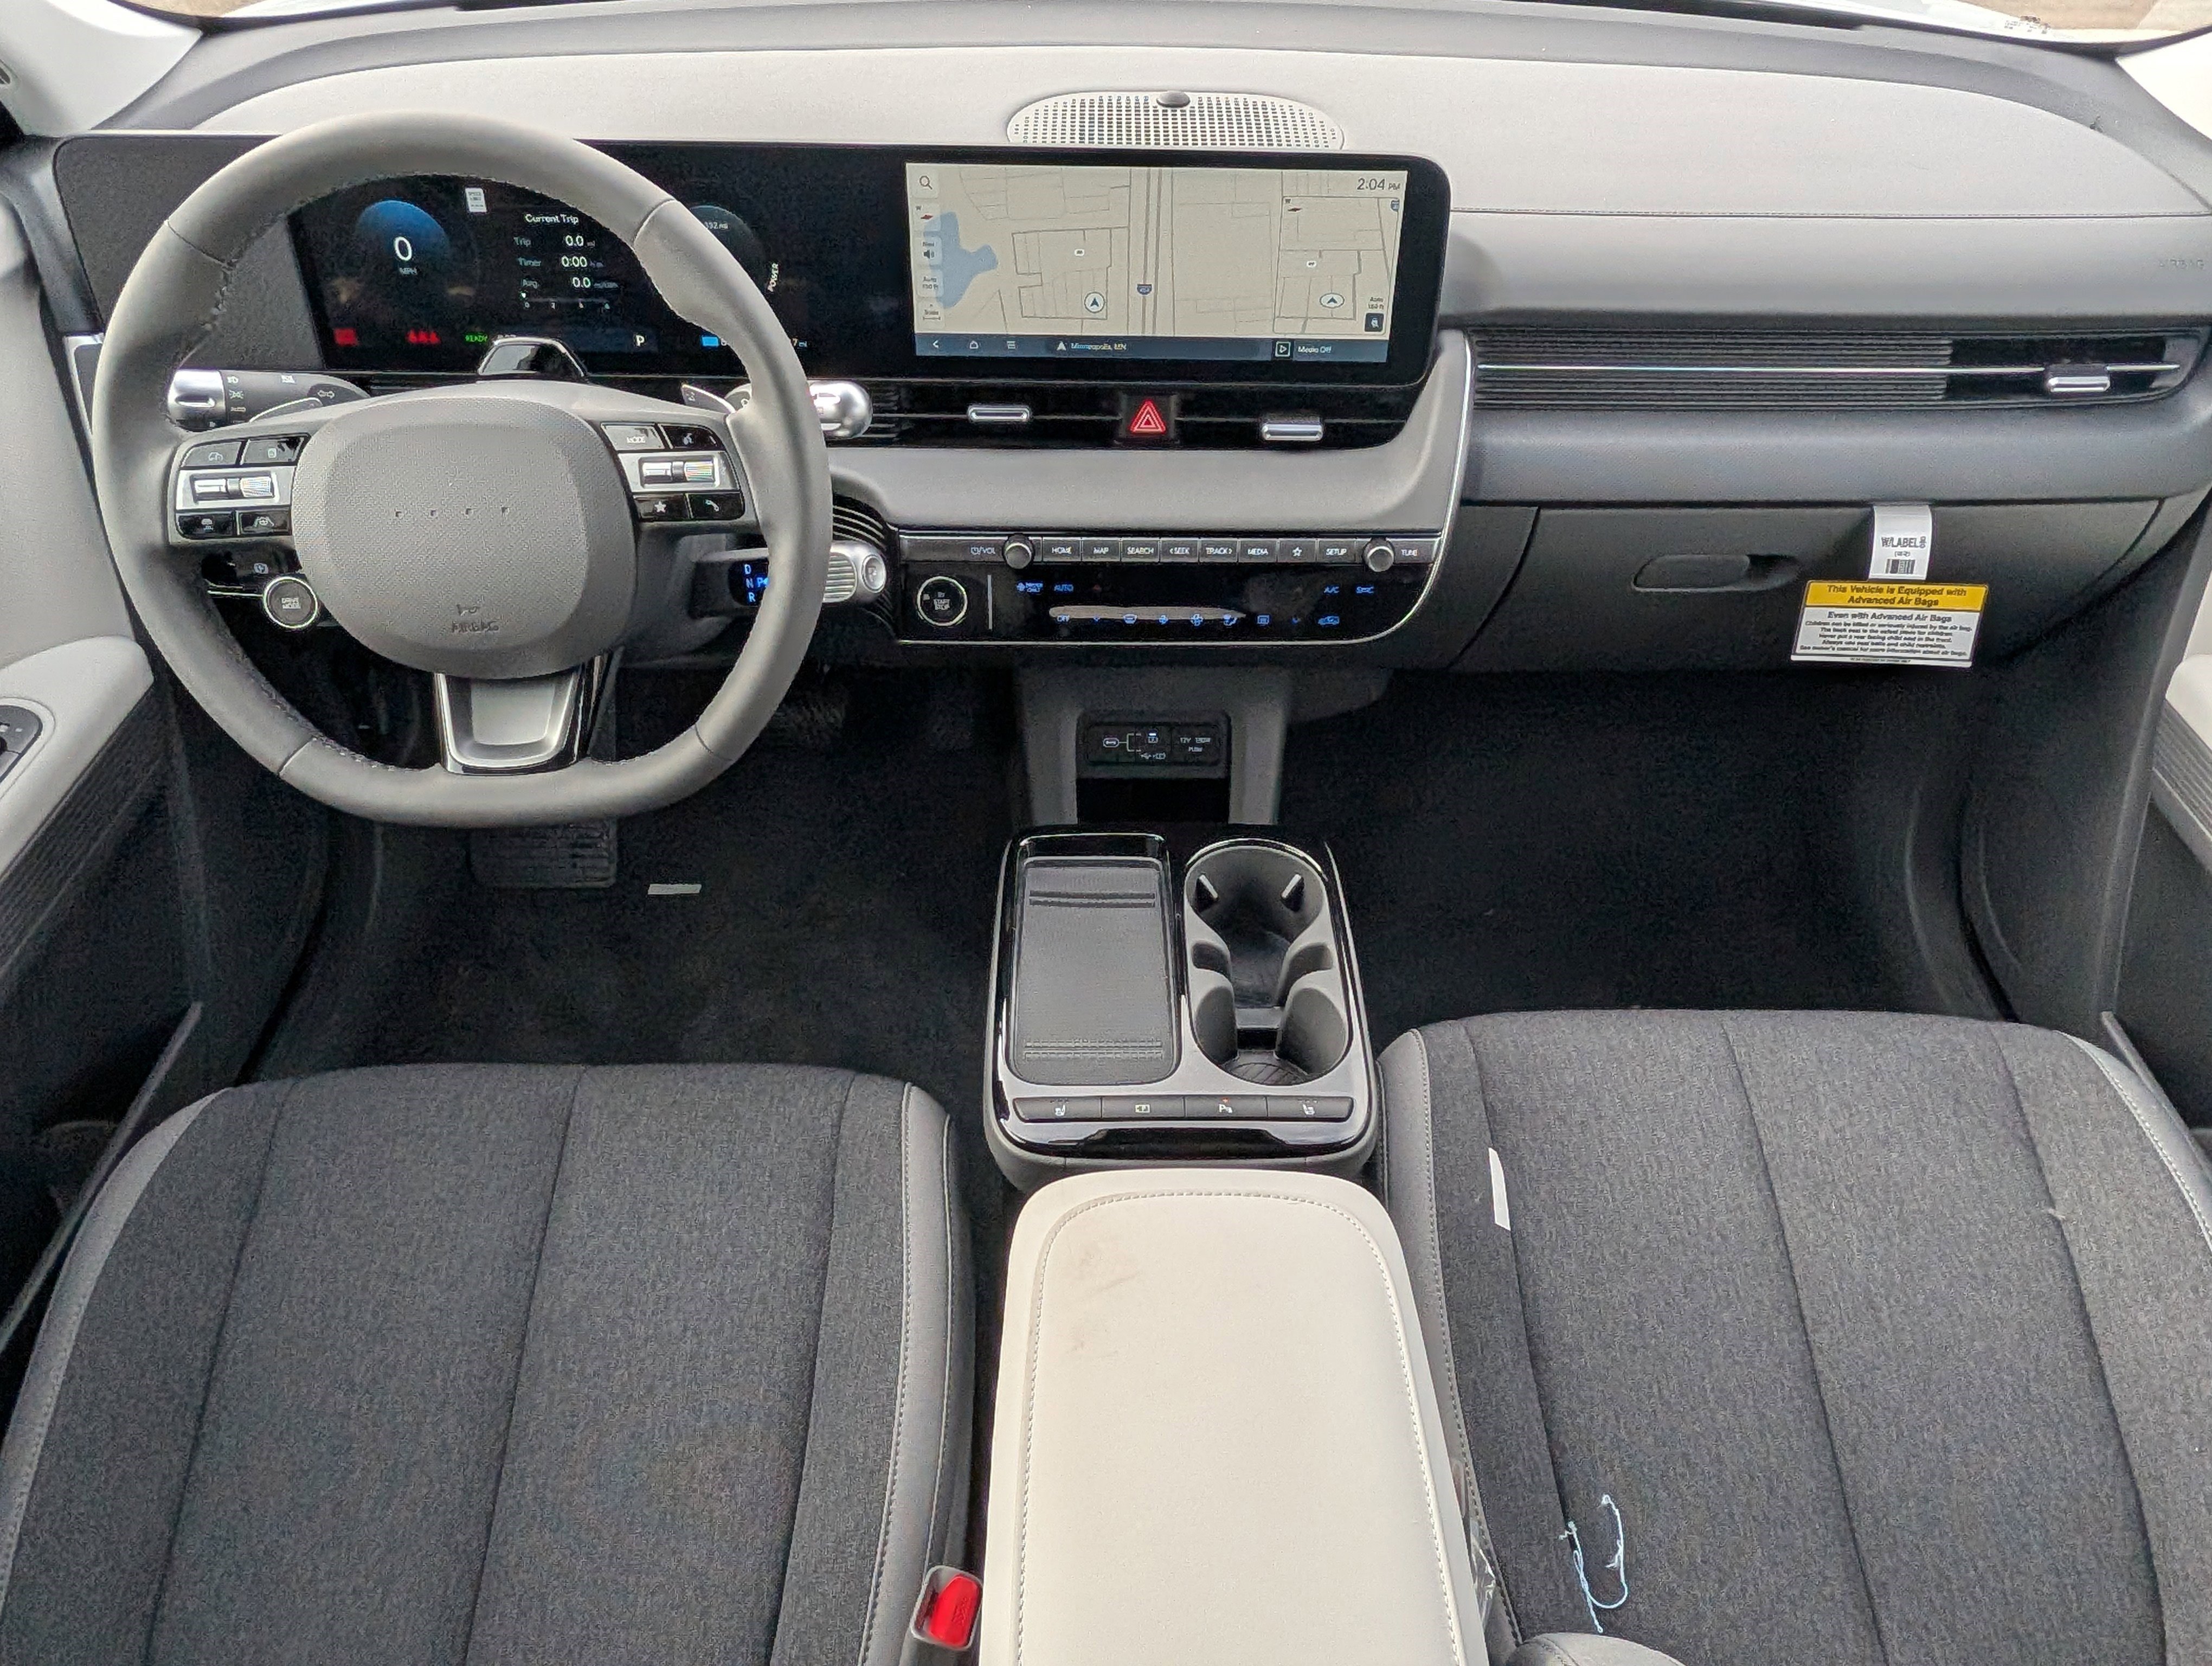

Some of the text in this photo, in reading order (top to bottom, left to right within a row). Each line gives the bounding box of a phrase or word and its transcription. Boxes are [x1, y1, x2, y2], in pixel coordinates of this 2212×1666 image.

[1357, 177, 1385, 190] 2:04
[525, 214, 579, 225] Current Trip
[514, 236, 531, 246] Trip
[565, 235, 584, 246] 0.0
[395, 236, 412, 261] 0
[561, 255, 587, 267] 0:00
[573, 277, 591, 288] 0.0
[636, 334, 645, 347] P
[1127, 547, 1154, 555] SEARCH
[744, 564, 751, 574] D
[745, 577, 763, 588] N P
[1827, 585, 1967, 597] This Vehicle is Equipped with
[748, 592, 756, 602] R
[1847, 595, 1939, 607] Advanced Air Bags
[1870, 613, 1914, 621] Advanced
[1930, 614, 1952, 623] Bags
